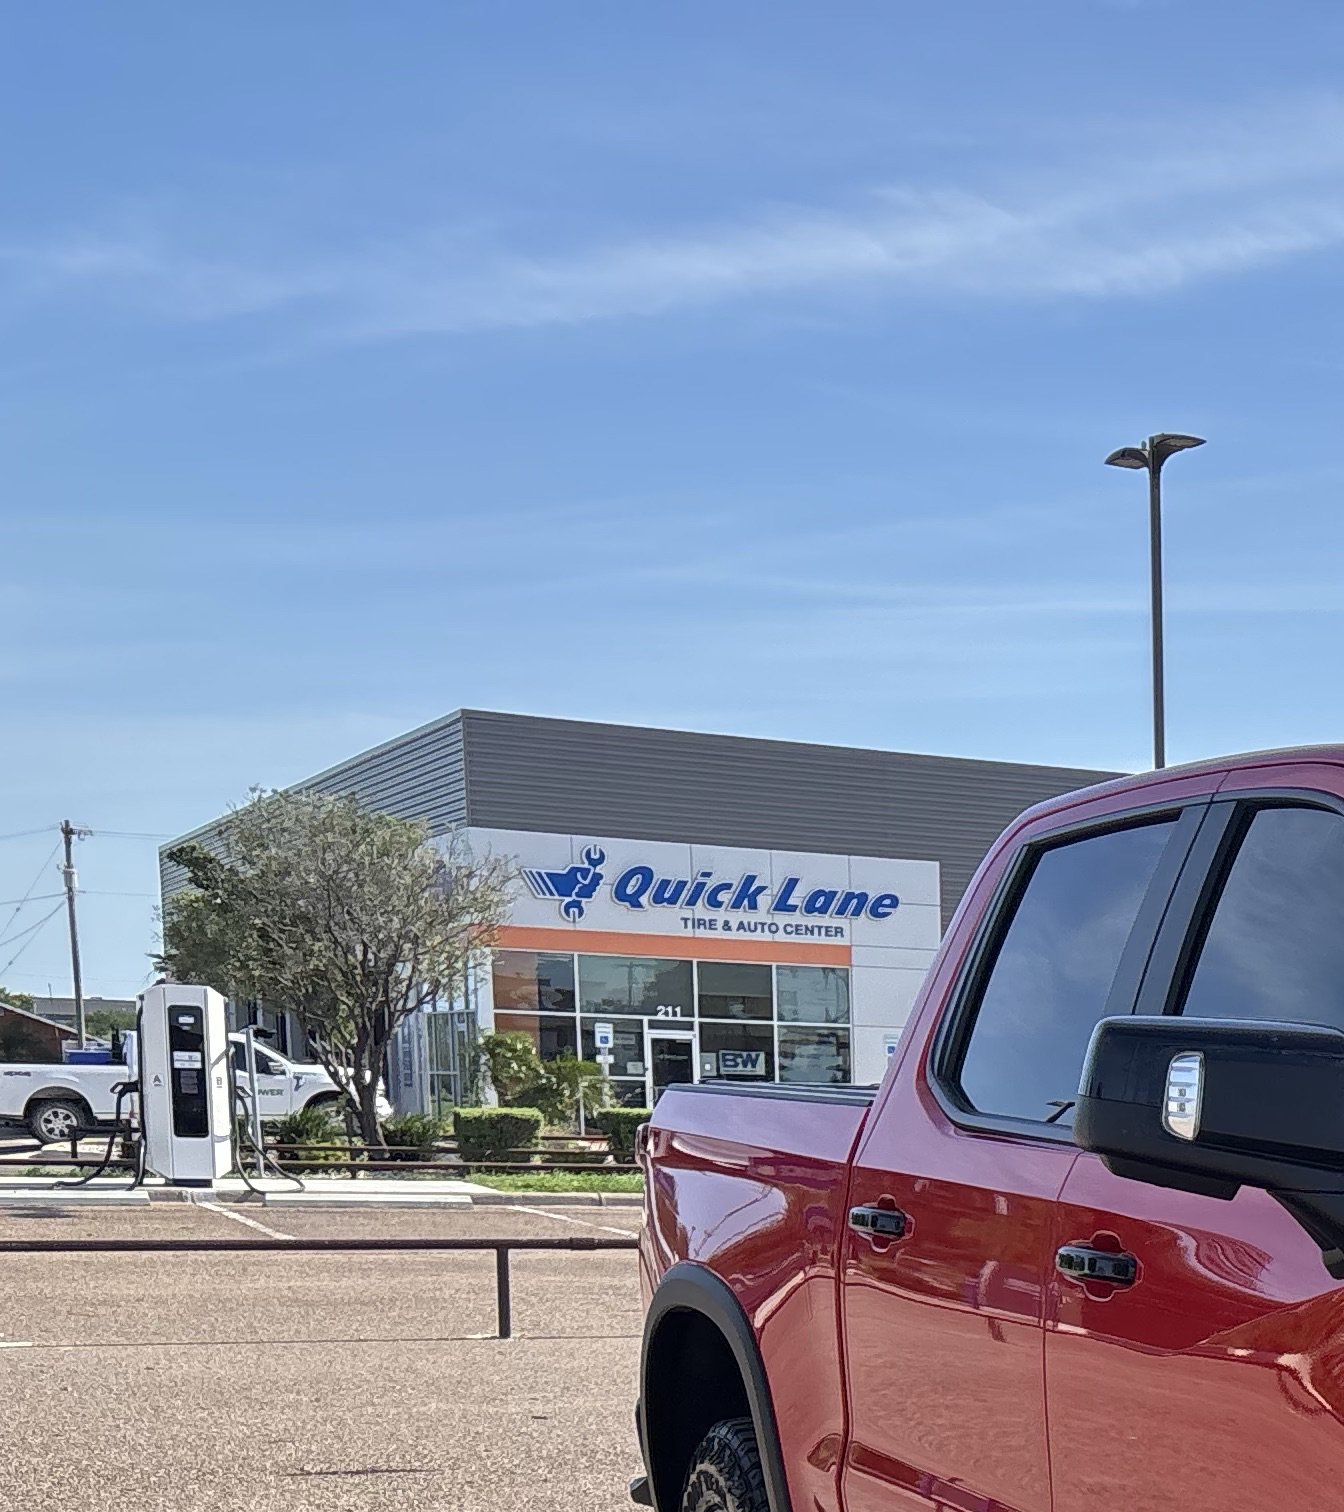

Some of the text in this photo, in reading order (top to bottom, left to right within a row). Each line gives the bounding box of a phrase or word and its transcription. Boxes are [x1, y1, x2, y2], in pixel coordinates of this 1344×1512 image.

[613, 865, 900, 918] Quick Lane
[681, 917, 845, 938] TIRE & AUTO CENTER
[656, 1004, 682, 1018] 211
